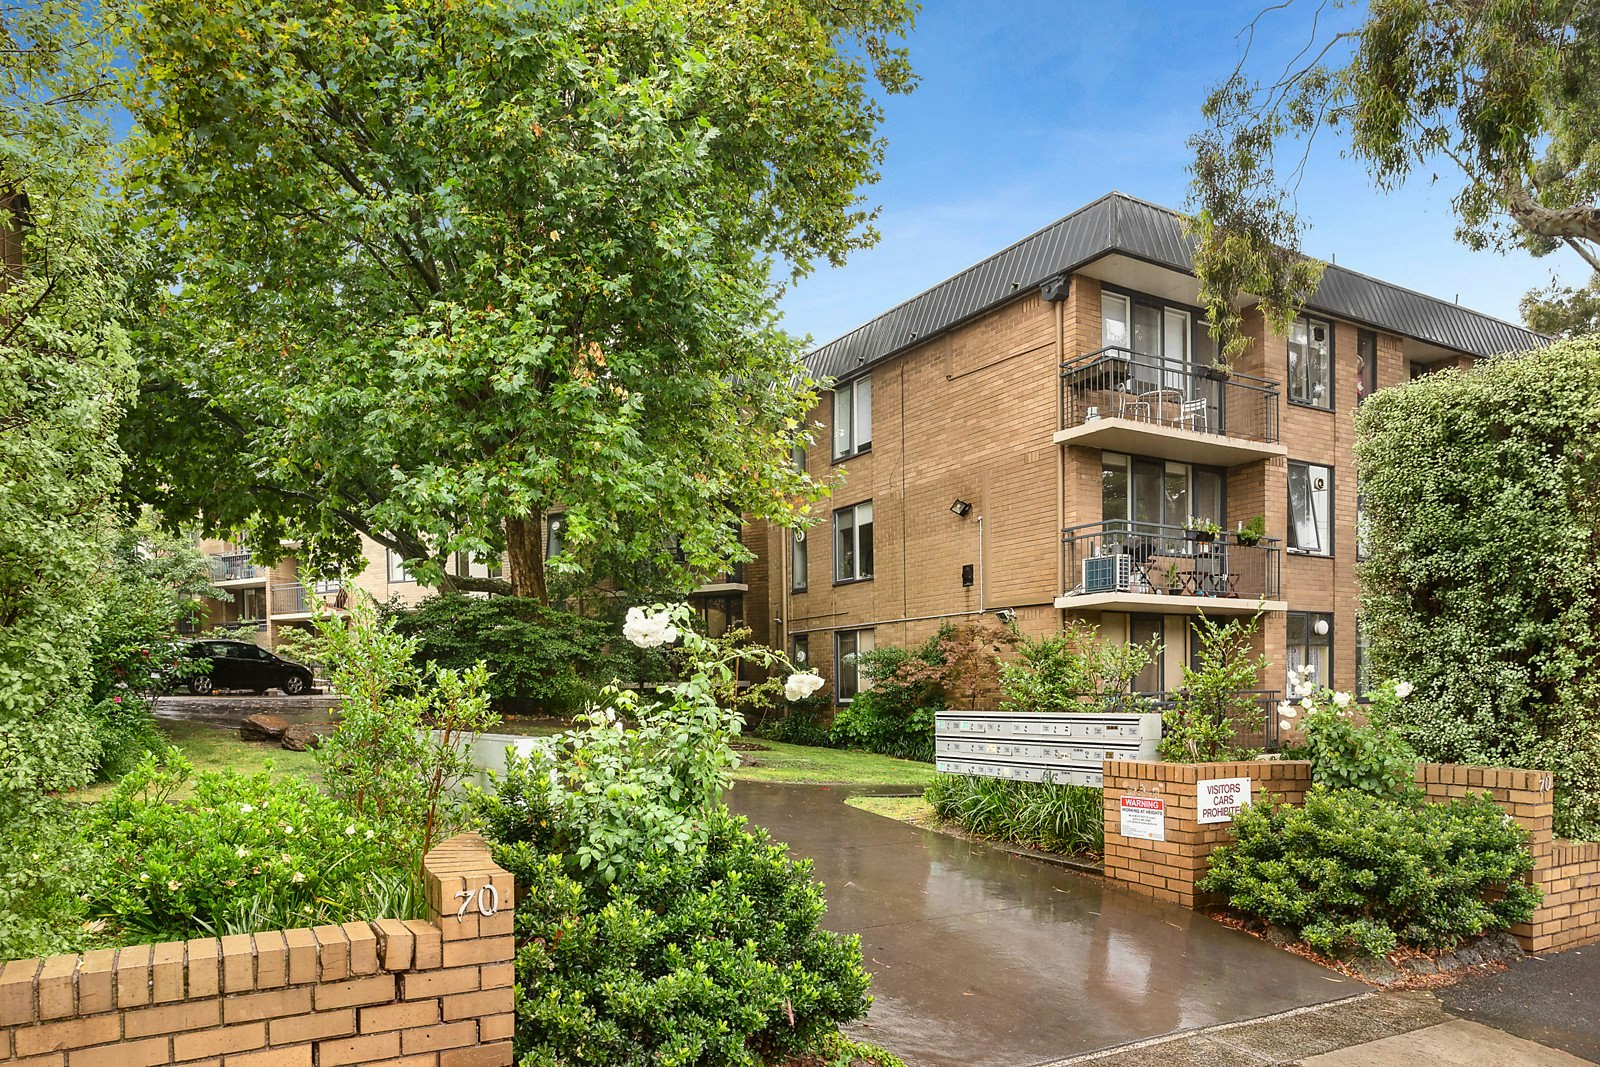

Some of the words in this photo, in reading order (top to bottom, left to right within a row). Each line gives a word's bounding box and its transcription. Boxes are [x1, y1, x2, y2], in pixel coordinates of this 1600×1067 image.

[1207, 783, 1241, 795] VISITORS
[1539, 775, 1551, 794] 70
[1125, 798, 1159, 809] WARNING
[1213, 795, 1234, 806] CARS
[1202, 805, 1242, 818] PROHIBITE
[454, 884, 499, 923] 70
